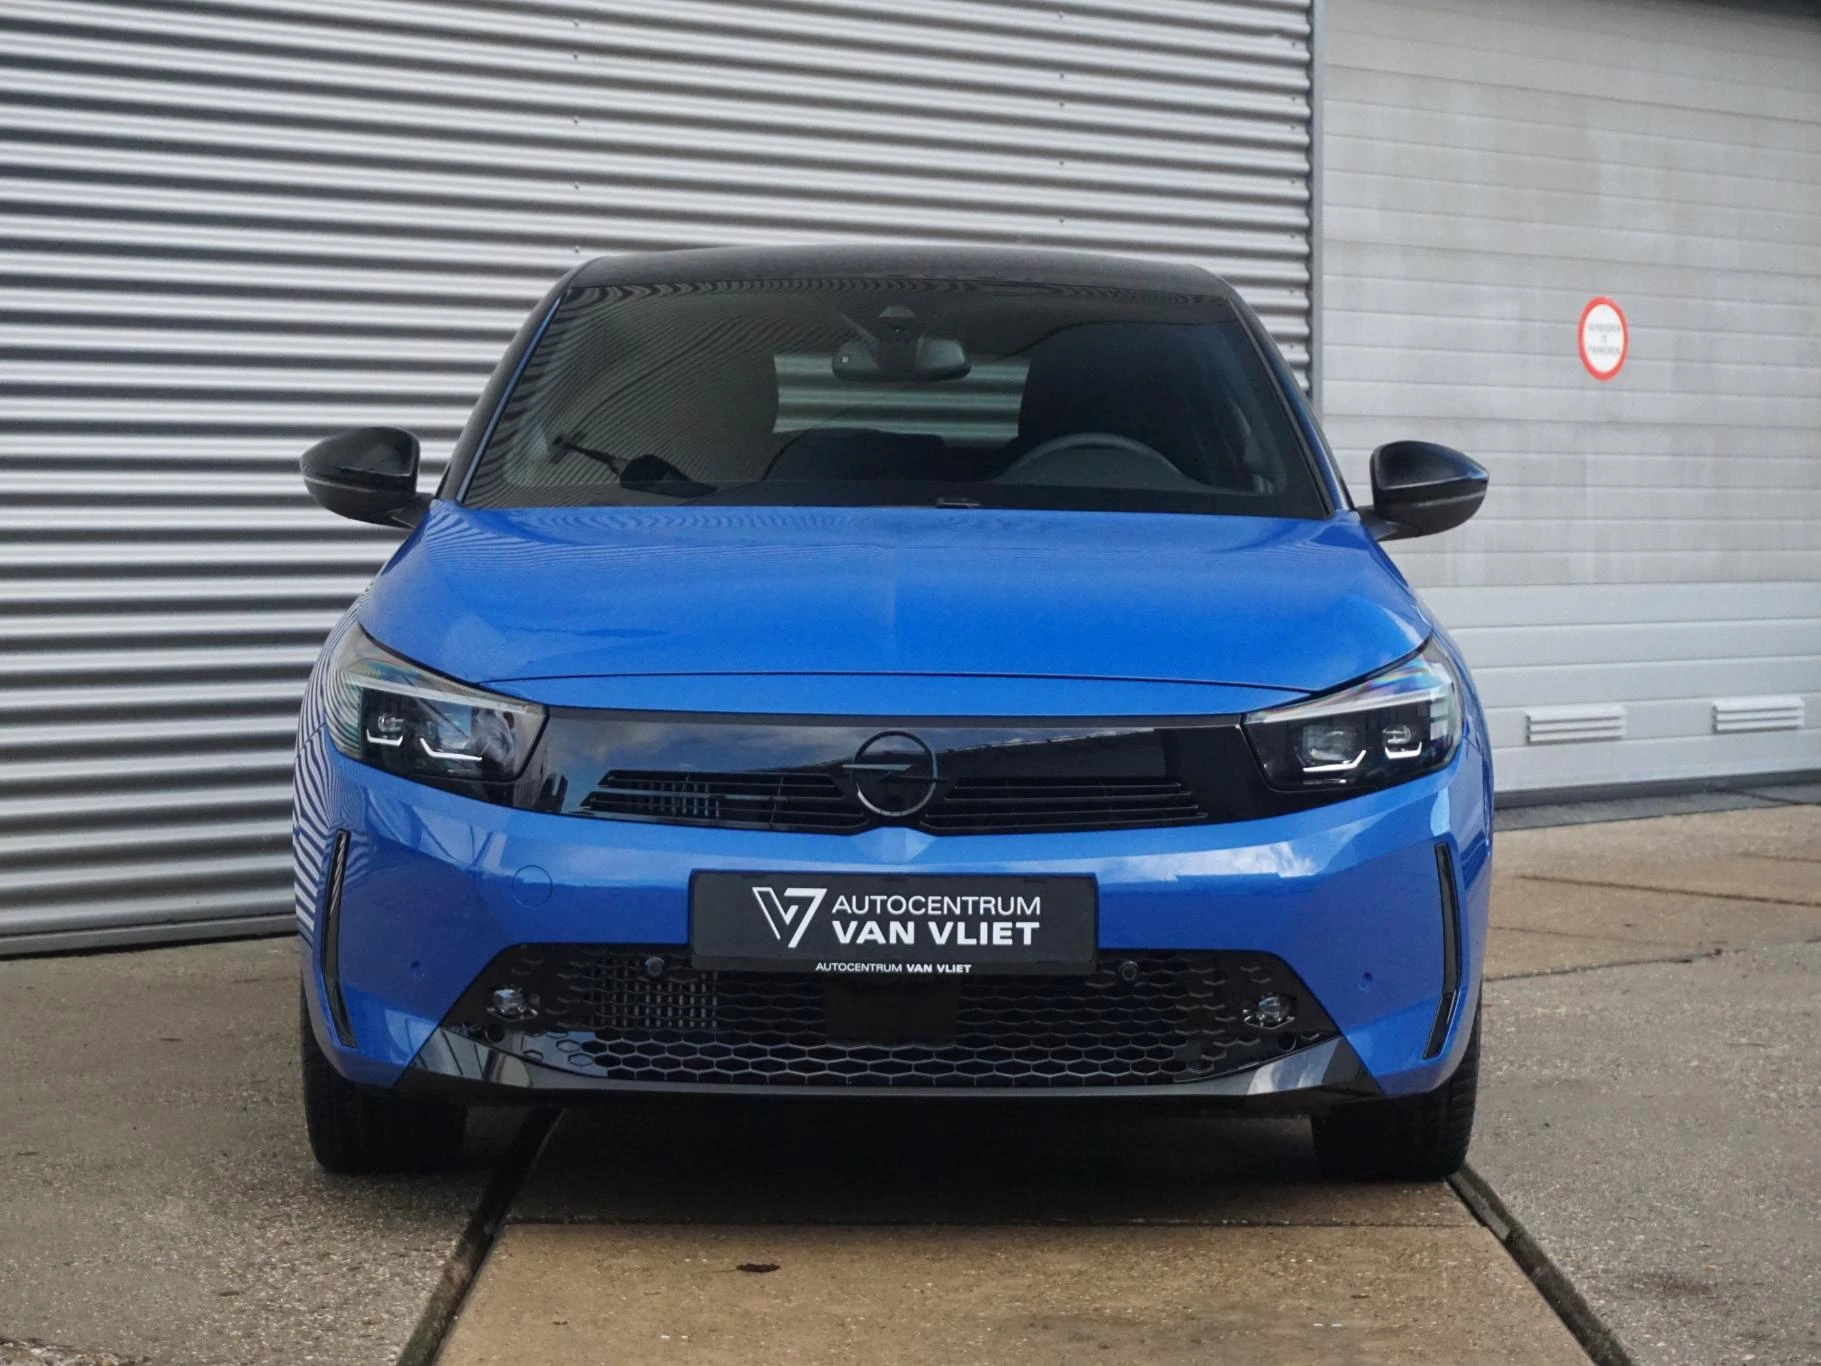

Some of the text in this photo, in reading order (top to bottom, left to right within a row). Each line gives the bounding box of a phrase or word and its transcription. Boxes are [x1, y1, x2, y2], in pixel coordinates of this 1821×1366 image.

[832, 894, 1041, 916] AUTOCENTRUM
[832, 921, 1040, 946] VAN VLIET
[815, 961, 972, 974] AUTOCENTRUM VAN VLIET
